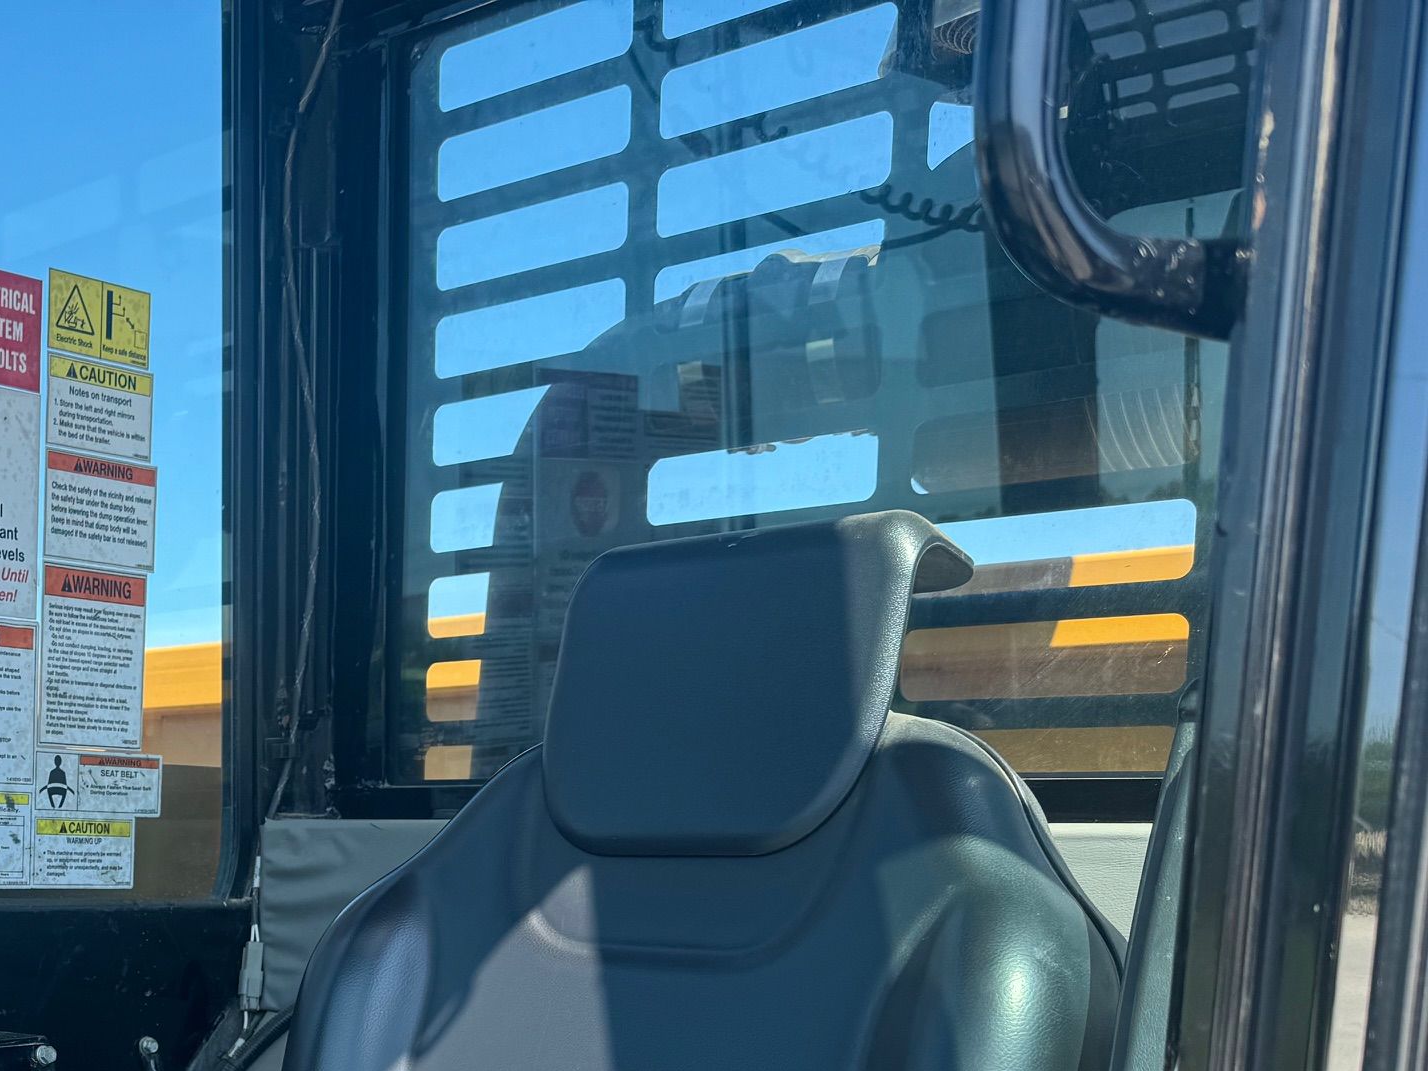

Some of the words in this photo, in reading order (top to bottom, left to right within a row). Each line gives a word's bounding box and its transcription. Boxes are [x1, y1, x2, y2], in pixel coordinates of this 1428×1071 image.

[78, 338, 93, 349] Shock
[79, 365, 136, 390] CAUTION
[69, 385, 89, 398] Notes
[90, 392, 100, 400] on
[101, 393, 132, 407] transport
[83, 460, 133, 480] WARNING
[1, 567, 29, 583] Until
[71, 575, 131, 599] WARNING
[104, 758, 141, 767] WARNING
[120, 771, 138, 779] BELT
[68, 822, 110, 834] CAUTION
[67, 837, 93, 845] WARMING
[94, 837, 102, 845] UP
